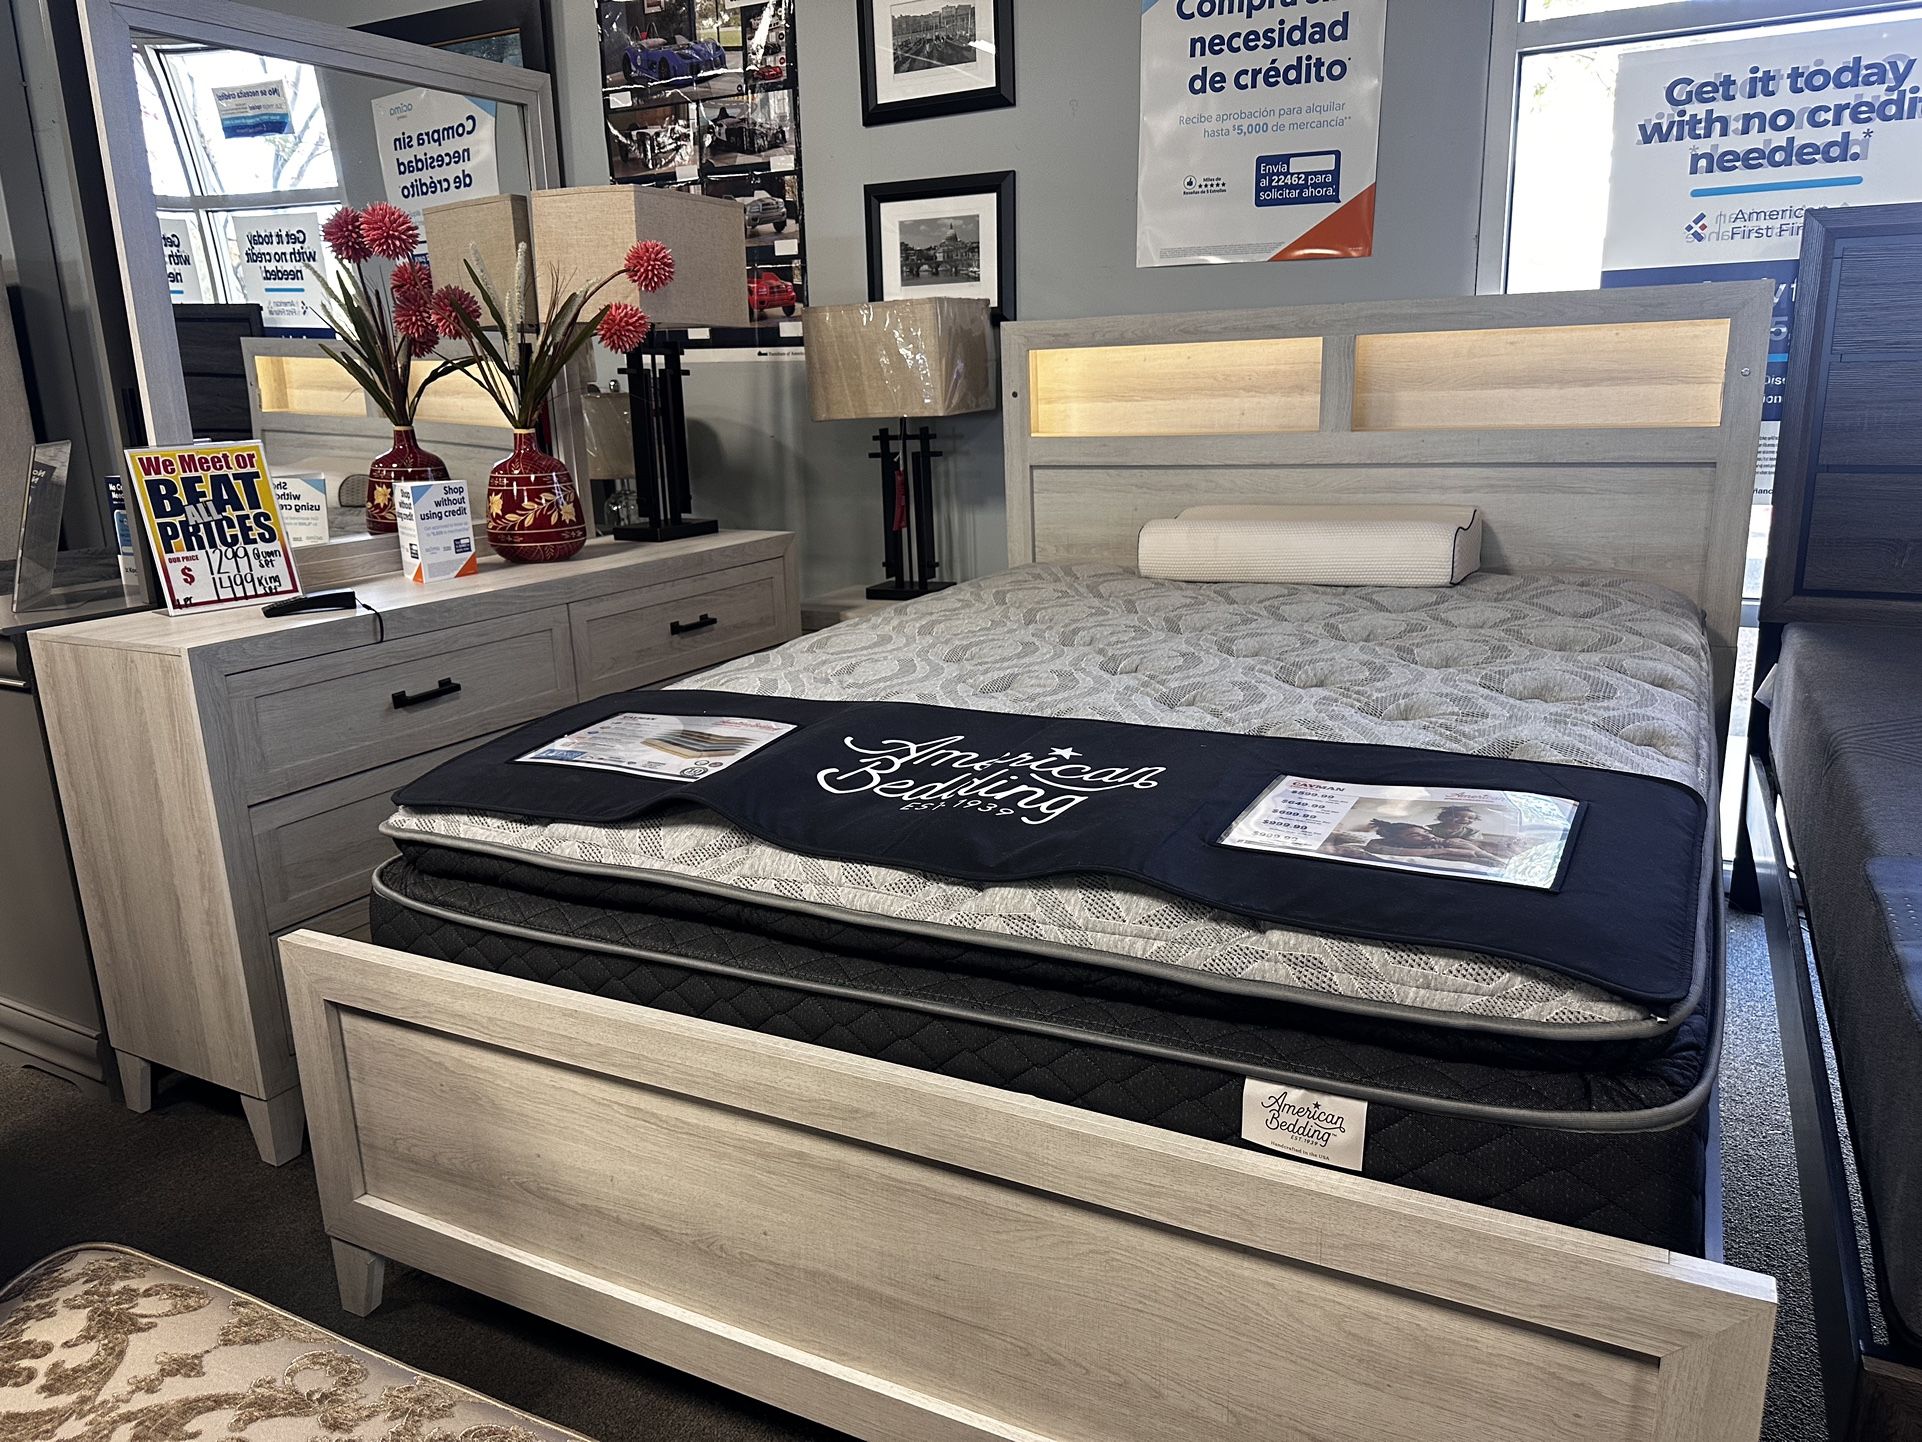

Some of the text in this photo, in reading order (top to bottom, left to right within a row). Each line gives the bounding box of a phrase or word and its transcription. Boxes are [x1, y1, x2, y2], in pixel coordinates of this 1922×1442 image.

[1189, 11, 1350, 58] necesidad
[1188, 66, 1227, 95] de
[1664, 56, 1917, 107] Get it today
[1179, 101, 1346, 128] Recibe aprobación para alquilar
[1637, 109, 1729, 144] with
[1740, 107, 1796, 136] no
[1203, 125, 1230, 139] hasta
[1232, 122, 1269, 136] $5,000
[1271, 120, 1286, 132] de
[1259, 173, 1332, 186] al 22462 para
[1260, 162, 1288, 174] Envía
[1259, 187, 1300, 200] solicitar
[1730, 224, 1773, 241] First
[137, 452, 257, 476] We Meet or
[143, 471, 261, 519] BEAT
[434, 495, 466, 508] without
[443, 485, 465, 496] Shop
[183, 500, 223, 526] ALL
[420, 506, 468, 521] using credit
[156, 511, 278, 554] PRICES
[181, 555, 200, 563] PRICE
[205, 546, 254, 576] 1299
[180, 565, 196, 586] $
[212, 572, 258, 601] 1499
[844, 735, 1167, 792] American
[816, 755, 1089, 825] Bedding
[952, 798, 1015, 817] 1939
[1261, 1091, 1346, 1133] American
[1270, 1141, 1302, 1154] Handcrafted
[1318, 1153, 1330, 1161] USA
[1291, 1134, 1319, 1146] EST. 1939
